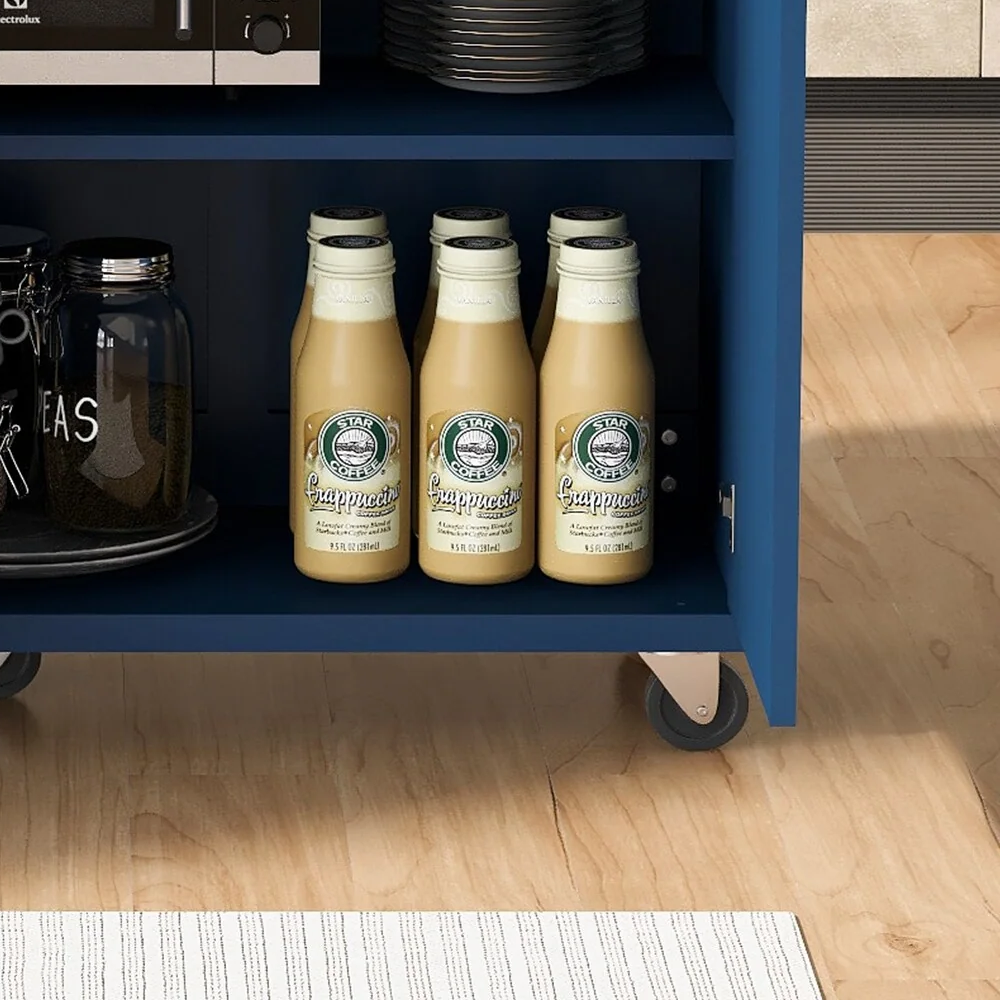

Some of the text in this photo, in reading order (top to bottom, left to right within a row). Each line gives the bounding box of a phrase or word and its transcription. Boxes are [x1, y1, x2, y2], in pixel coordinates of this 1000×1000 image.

[337, 417, 374, 430] STAR
[457, 418, 495, 431] STAR
[592, 418, 628, 431] STAR
[330, 459, 380, 479] COFFEE
[451, 460, 500, 480] COFFEE
[585, 459, 636, 479] COFFEE
